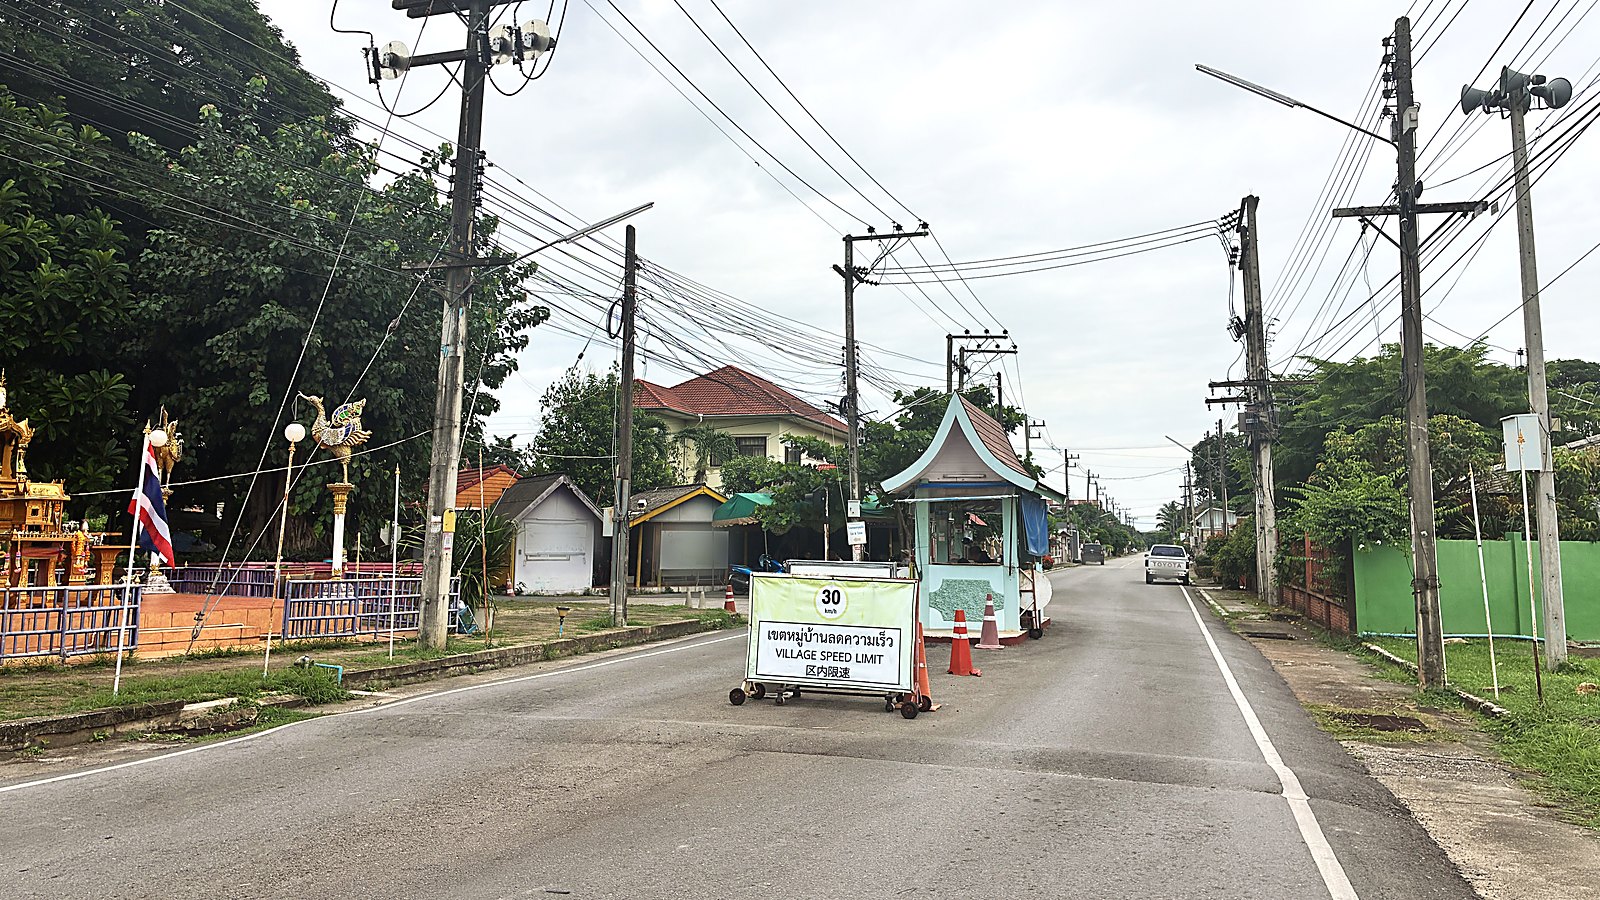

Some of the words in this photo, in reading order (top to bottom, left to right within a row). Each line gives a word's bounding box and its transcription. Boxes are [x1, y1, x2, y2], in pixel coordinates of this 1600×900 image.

[822, 589, 841, 605] 30
[767, 627, 894, 648] เขตหมู่บ้านลดความเร็ว
[775, 648, 817, 661] VILLAGE
[820, 651, 852, 663] SPEED
[855, 653, 884, 665] LIMIT
[805, 665, 851, 679] 区内限速
